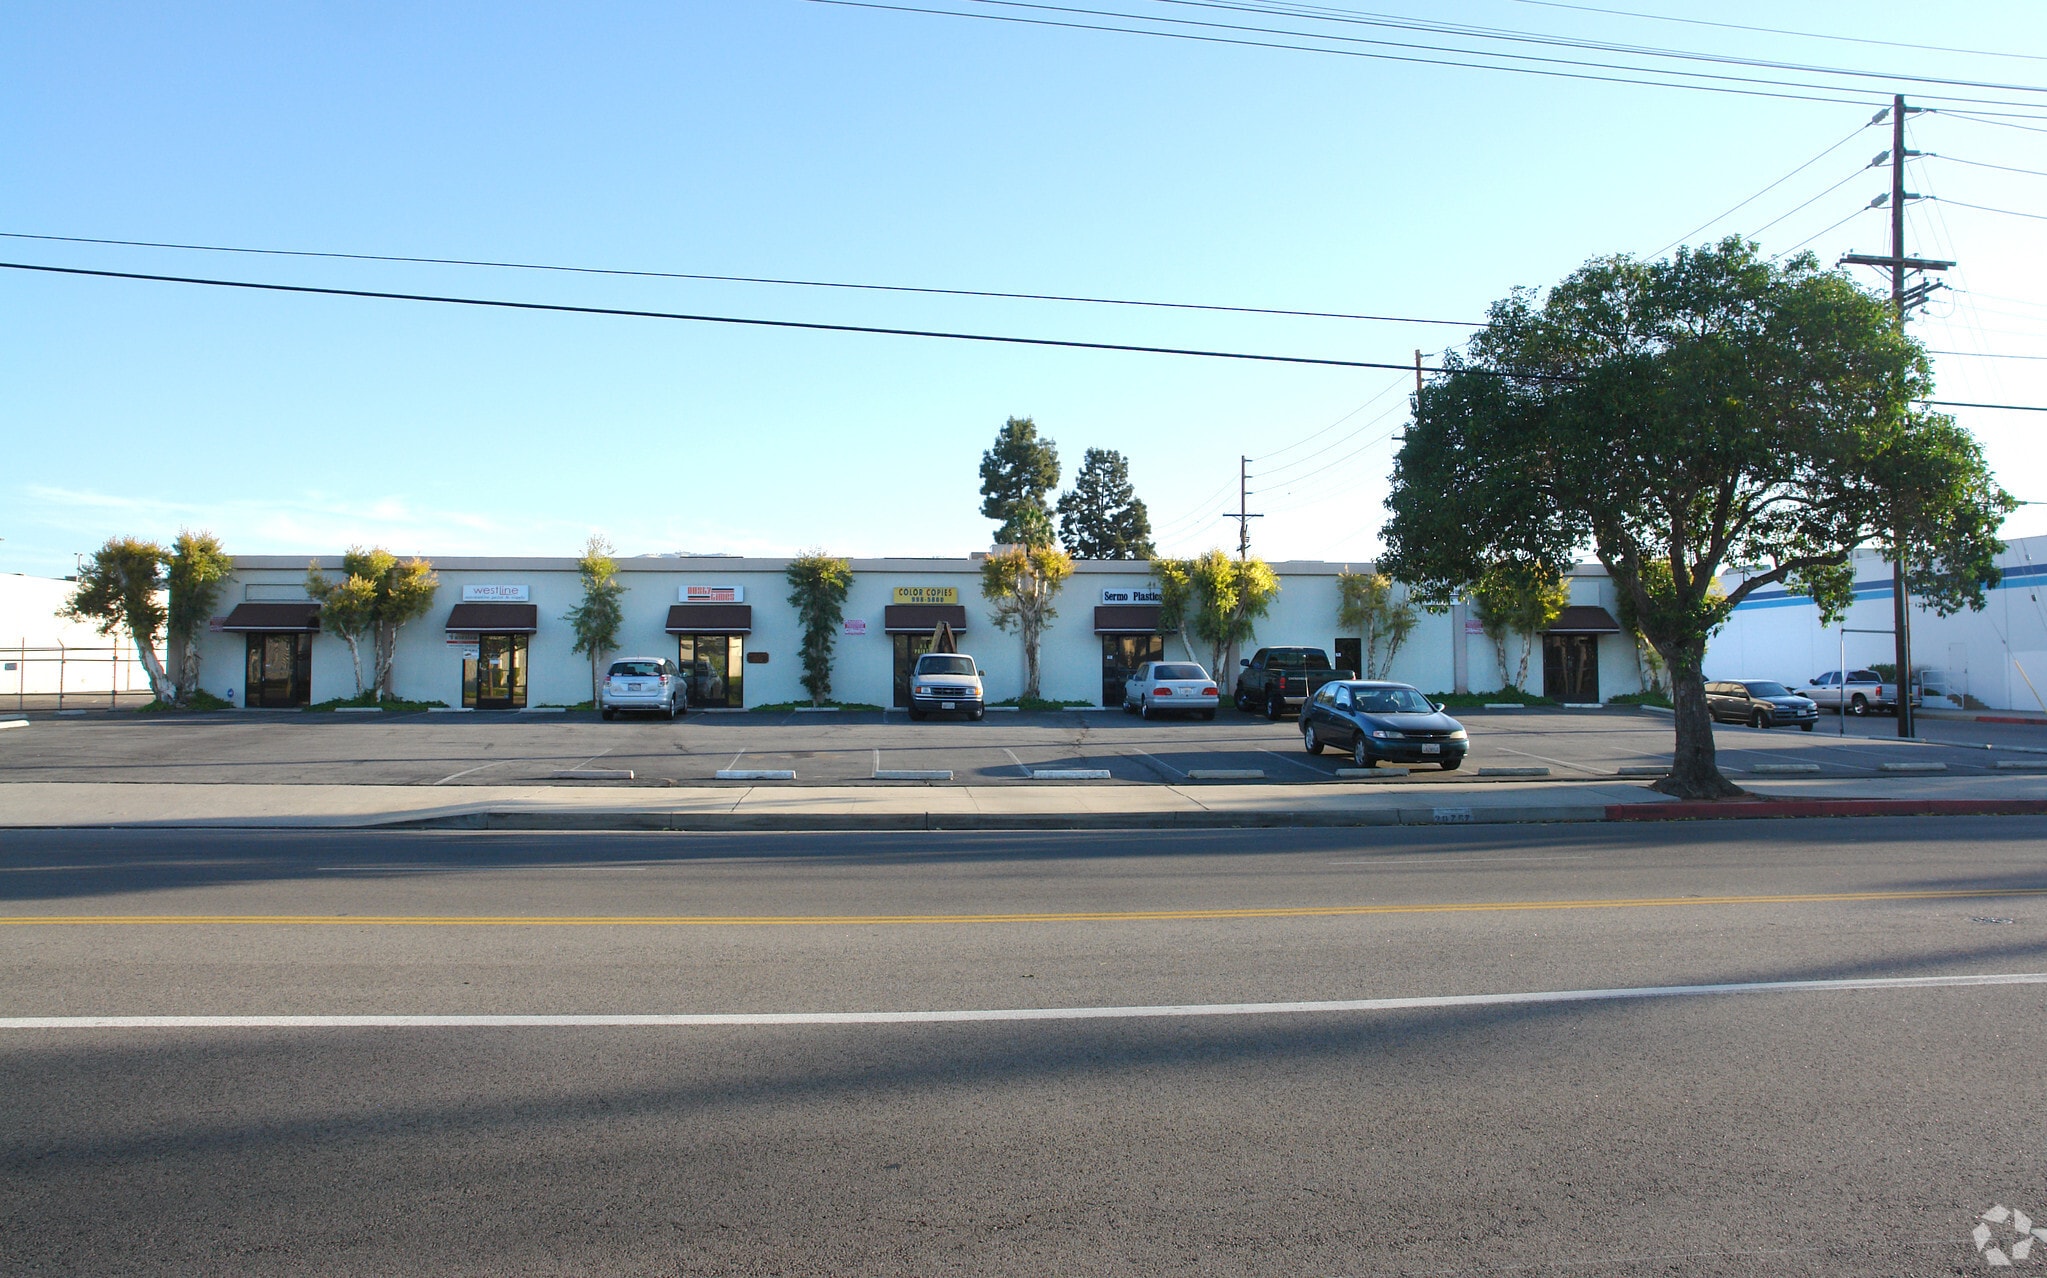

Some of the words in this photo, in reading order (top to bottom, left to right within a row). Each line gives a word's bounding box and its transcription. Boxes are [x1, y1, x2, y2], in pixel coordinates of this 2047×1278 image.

[473, 585, 519, 596] westline
[898, 588, 923, 596] COLOR
[926, 588, 953, 597] COPIES
[1104, 591, 1129, 601] Sermo
